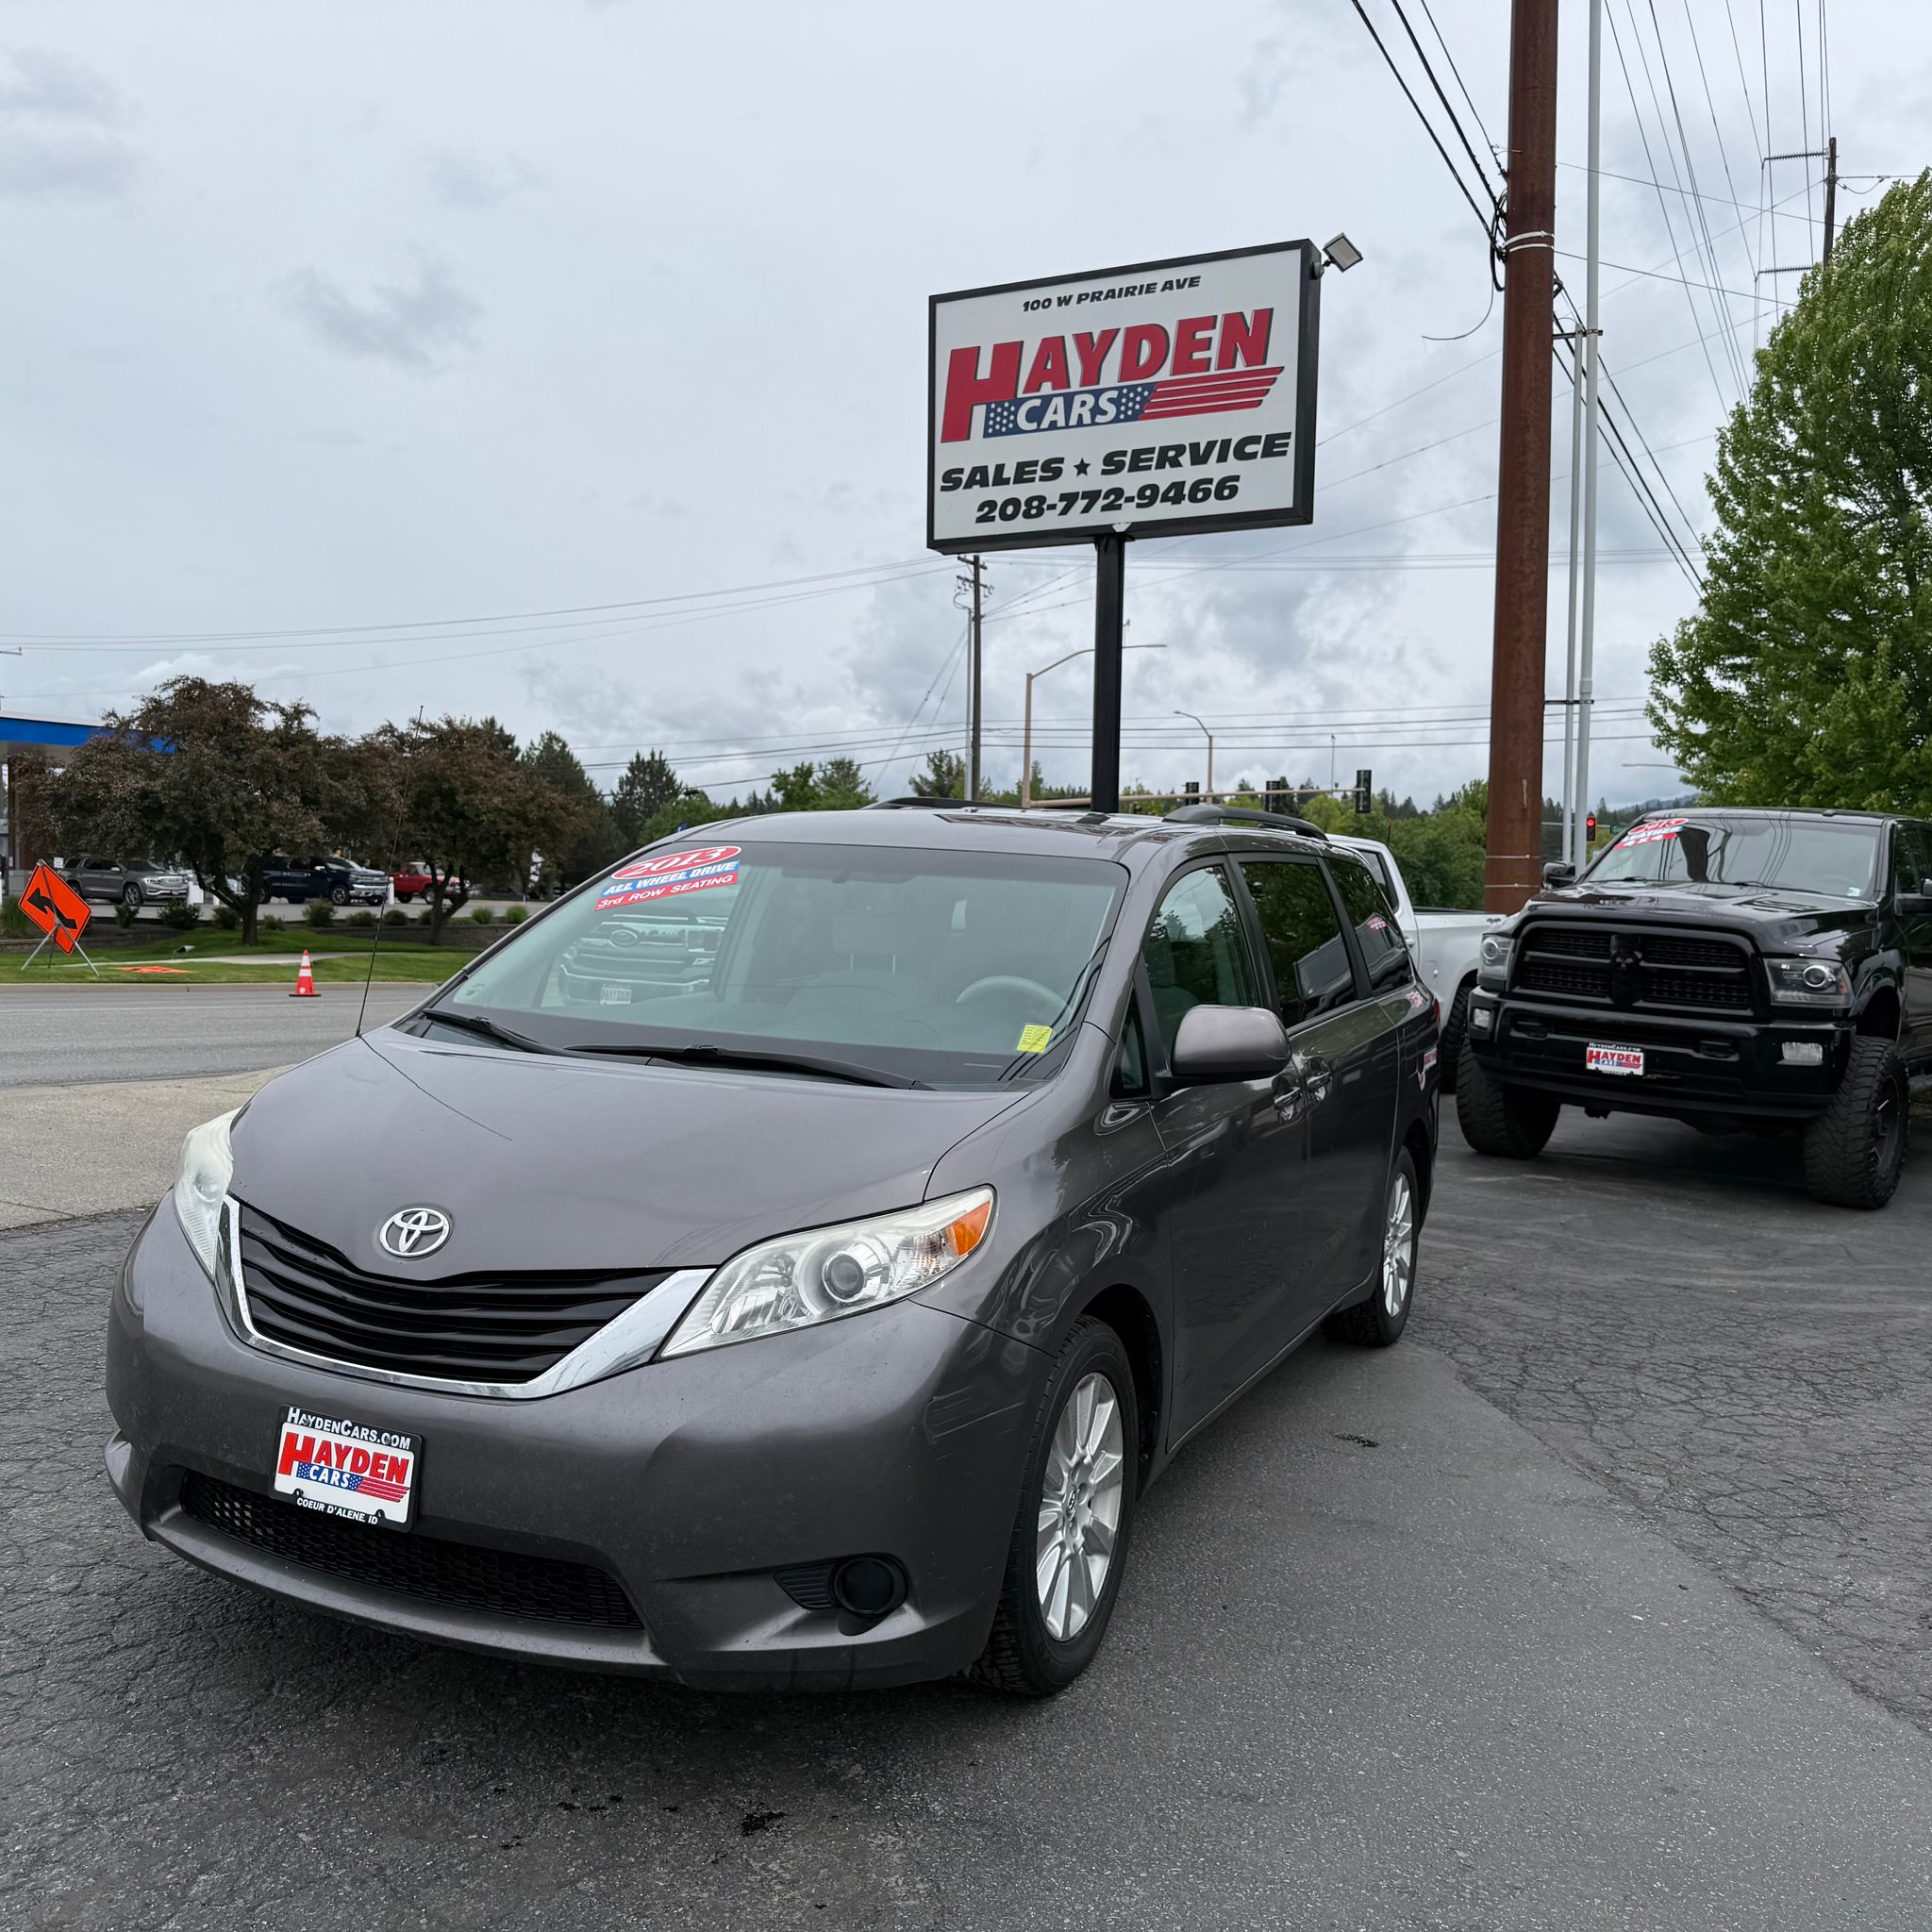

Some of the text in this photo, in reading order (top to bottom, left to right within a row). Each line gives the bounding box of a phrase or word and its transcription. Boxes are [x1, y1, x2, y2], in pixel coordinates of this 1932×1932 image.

[1023, 275, 1201, 312] 100 W PRAIRIE AVE
[941, 308, 1274, 443] HAYDEN
[1016, 390, 1119, 431] CARS
[941, 432, 1292, 491] SALES SERVICE
[974, 475, 1241, 524] 208-772-9466
[602, 860, 739, 895] ALL WHEEL DRIVE
[621, 847, 727, 878] 2013
[597, 874, 734, 908] 3rd ROW SEATING
[1587, 1049, 1641, 1064] HAYDEN
[278, 1432, 409, 1485] HAYDEN
[308, 1464, 350, 1489] CARS
[296, 1497, 325, 1512] COEUR
[368, 1515, 378, 1525] ID
